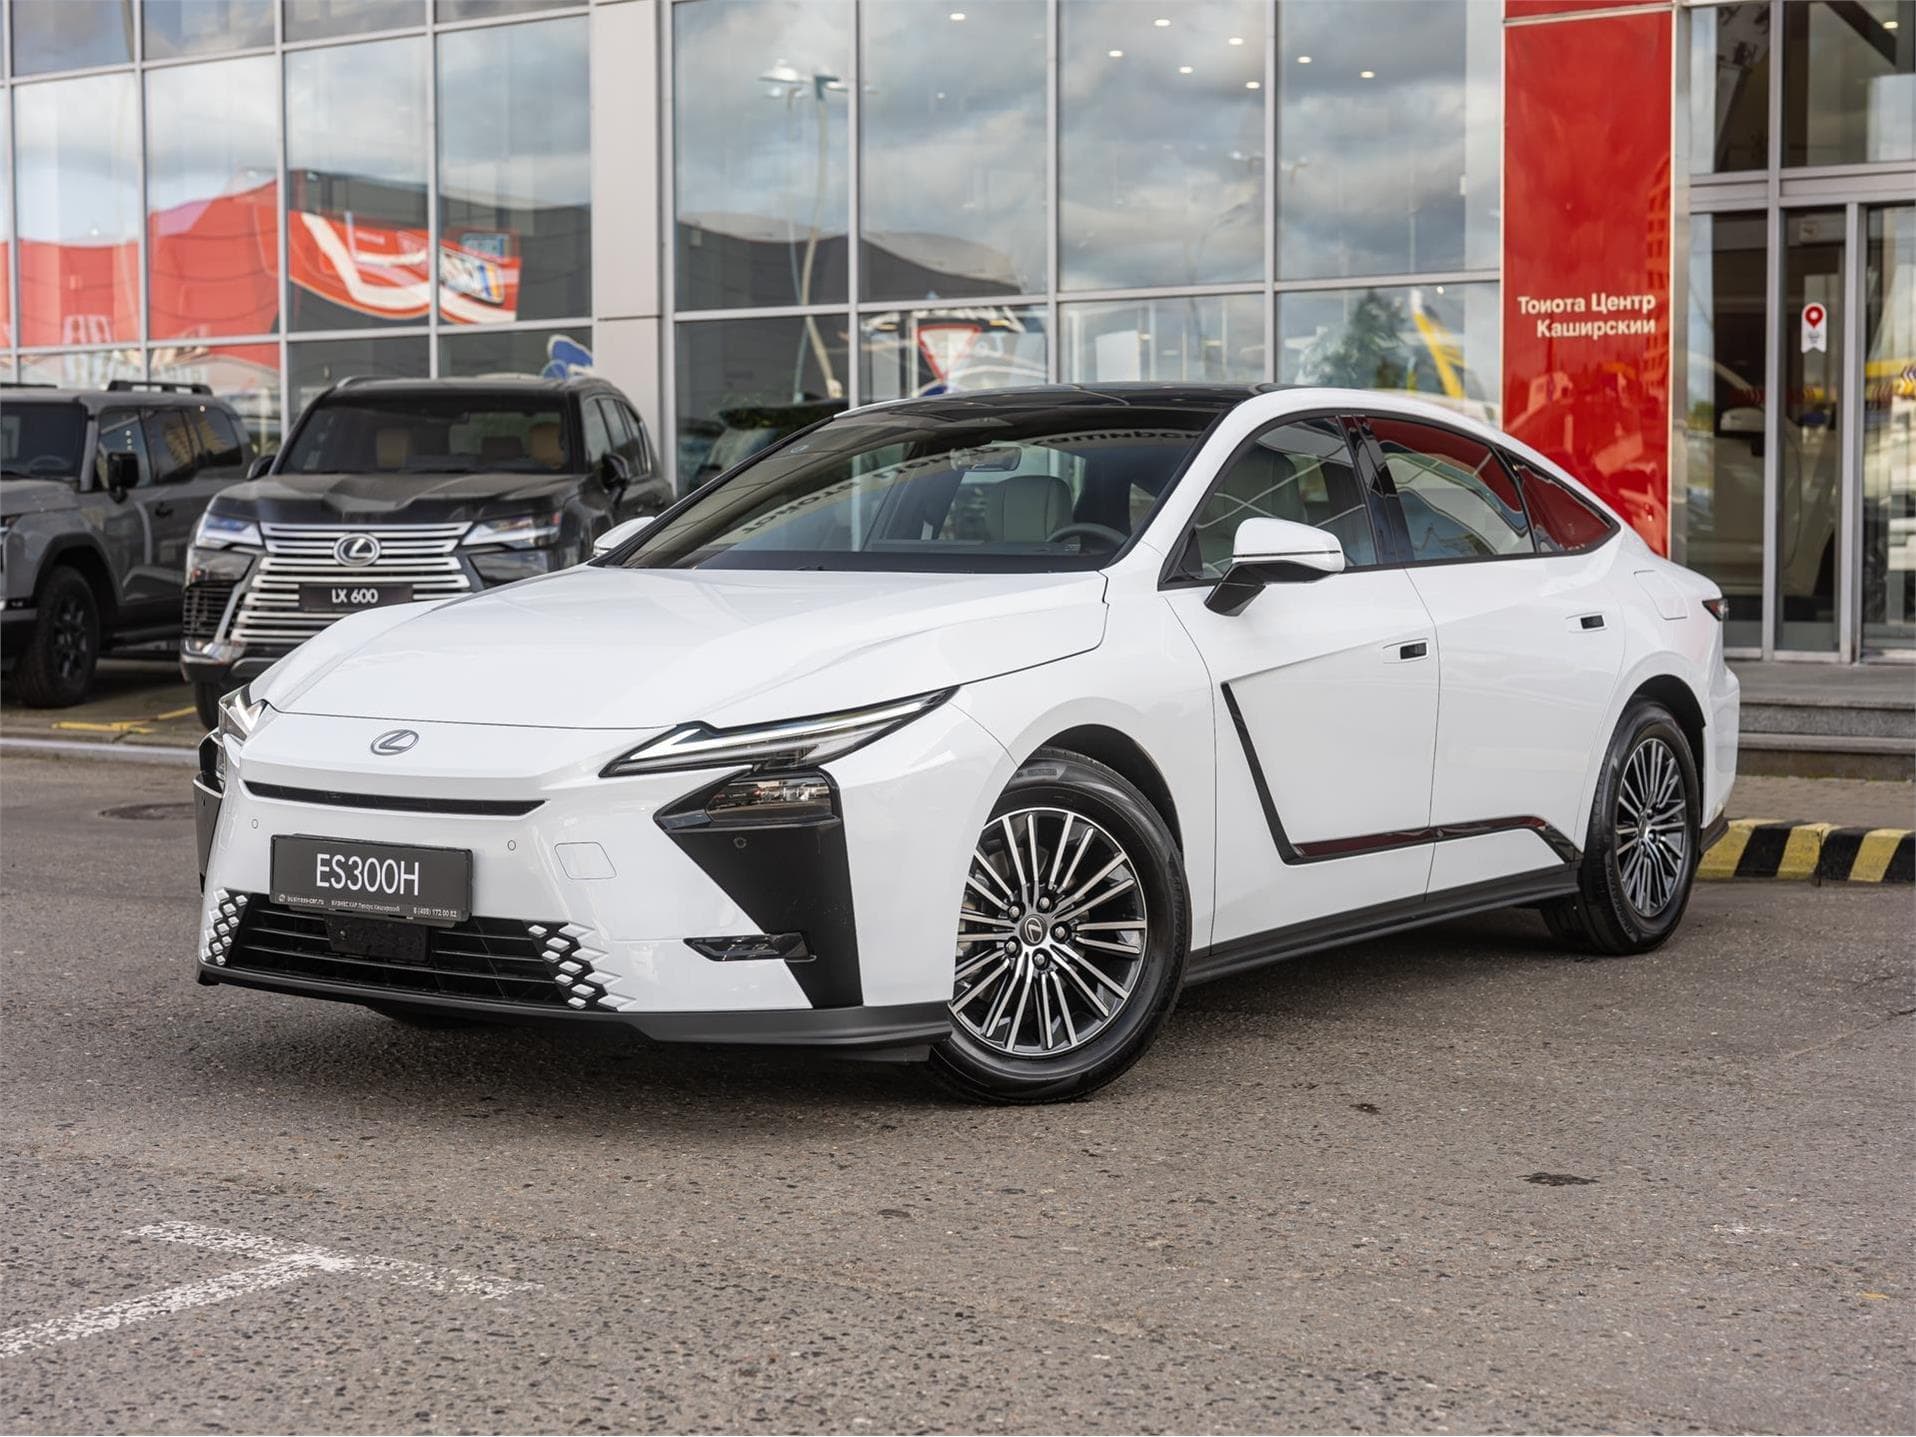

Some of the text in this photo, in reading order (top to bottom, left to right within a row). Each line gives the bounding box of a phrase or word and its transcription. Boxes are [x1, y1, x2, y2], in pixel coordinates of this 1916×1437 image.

[1591, 293, 1656, 315] Центр
[331, 588, 378, 603] LX 600
[316, 853, 420, 896] ES300H
